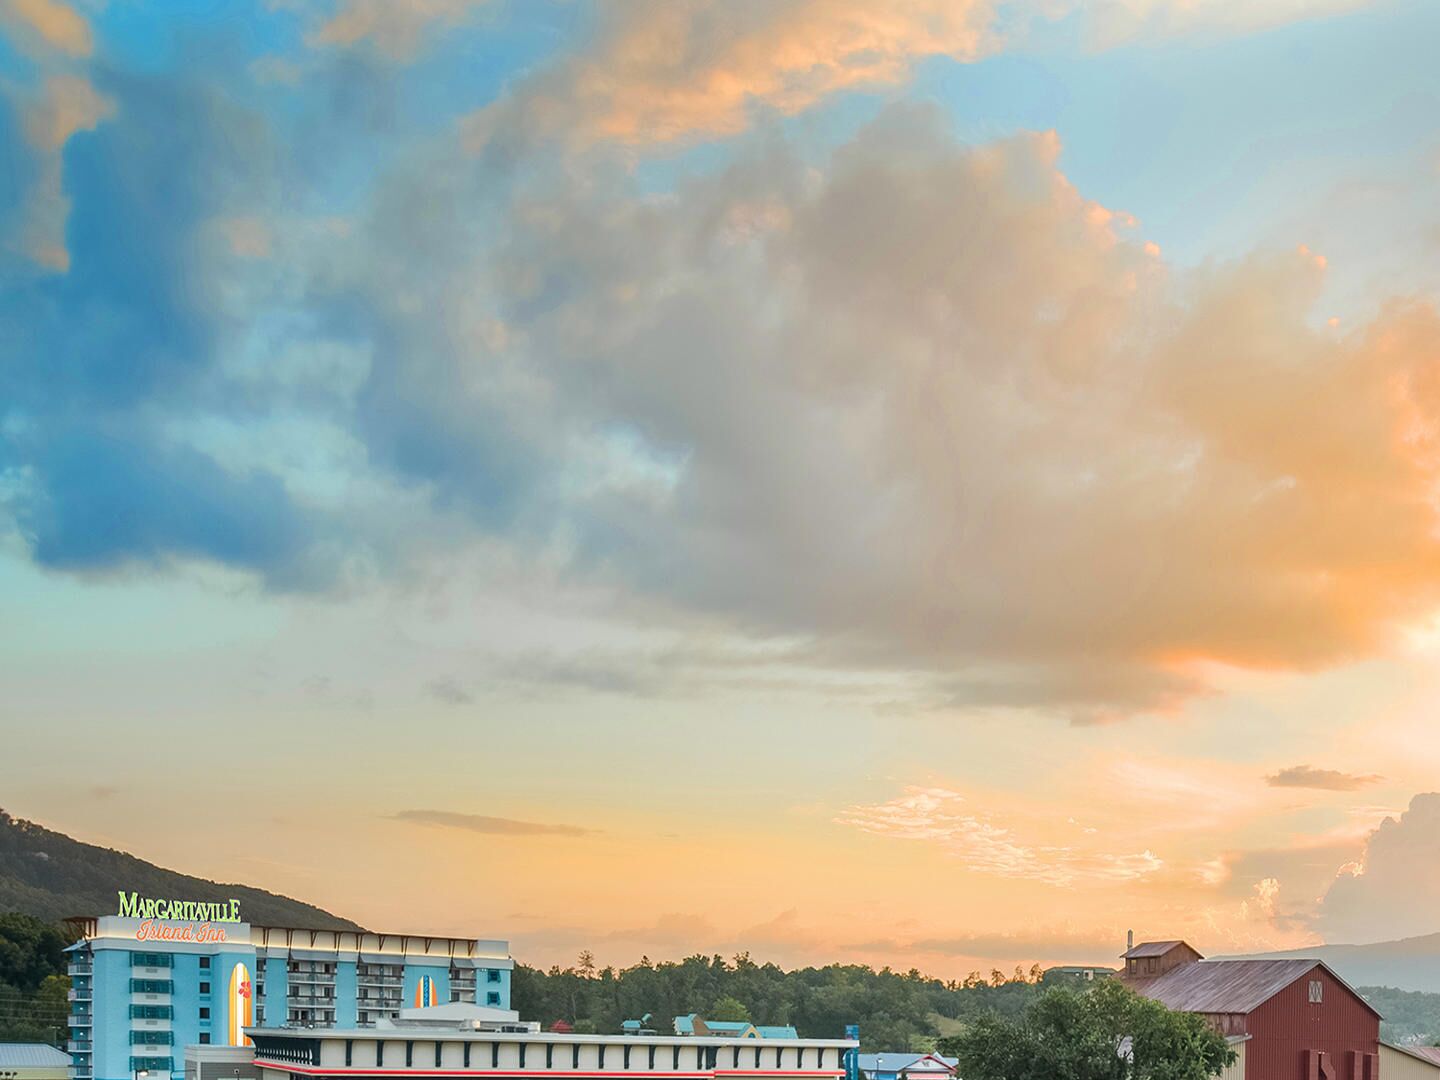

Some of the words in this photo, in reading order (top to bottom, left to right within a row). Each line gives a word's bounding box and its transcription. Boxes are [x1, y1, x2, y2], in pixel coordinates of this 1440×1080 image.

[118, 891, 241, 922] MARGARITAVILLE
[136, 919, 194, 941] Island
[196, 921, 226, 942] Inn
